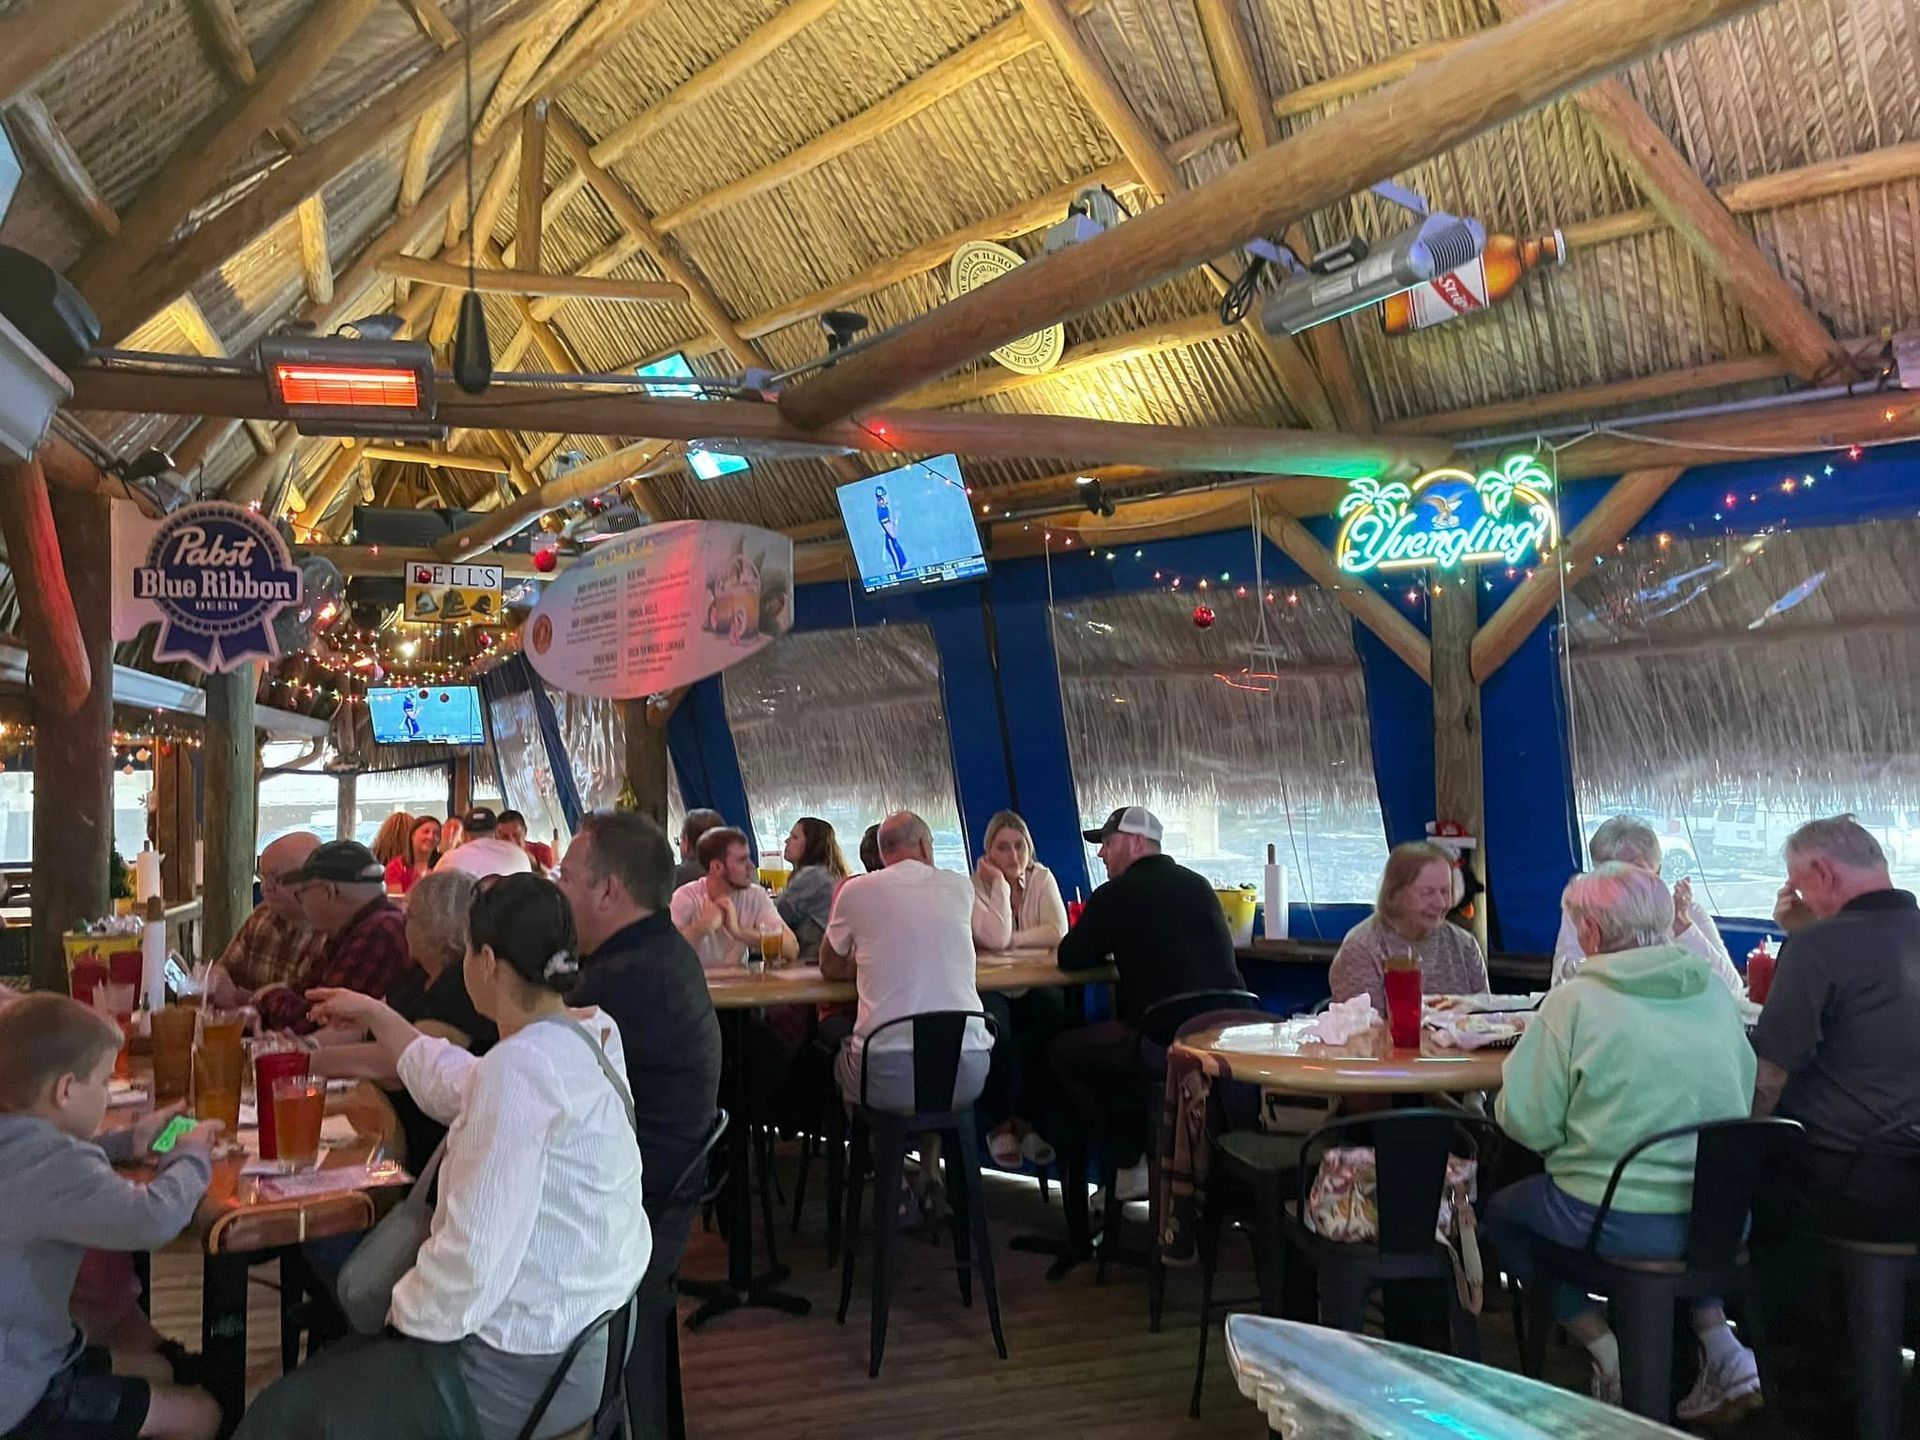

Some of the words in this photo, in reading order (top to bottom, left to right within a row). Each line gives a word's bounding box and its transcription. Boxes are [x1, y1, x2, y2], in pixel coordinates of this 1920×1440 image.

[982, 252, 1012, 269] ORTH
[172, 525, 258, 567] Pabst
[1343, 512, 1539, 573] Yuengling
[140, 570, 196, 599] Blue
[200, 570, 292, 600] Ribbon
[195, 601, 239, 611] BEER
